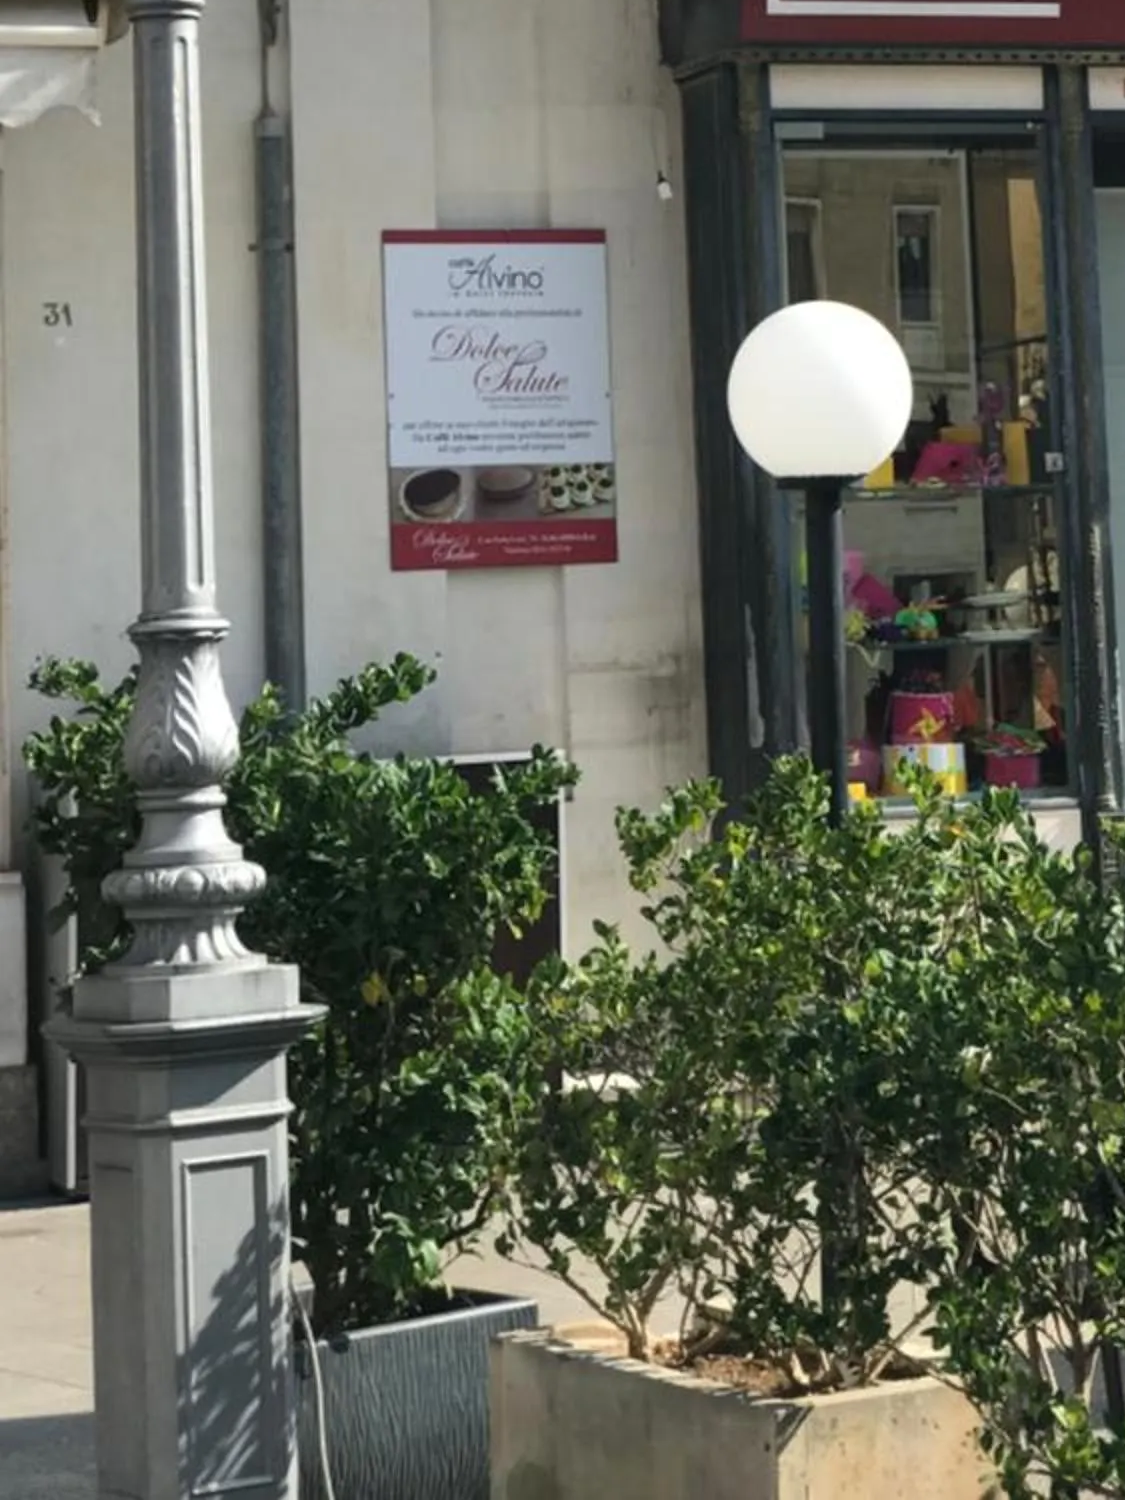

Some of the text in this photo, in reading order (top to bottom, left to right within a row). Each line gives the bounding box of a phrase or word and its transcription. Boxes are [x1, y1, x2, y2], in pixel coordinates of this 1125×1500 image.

[448, 253, 543, 290] Alvino
[43, 302, 73, 327] 31
[429, 324, 518, 362] Dolce
[473, 340, 569, 393] Salute
